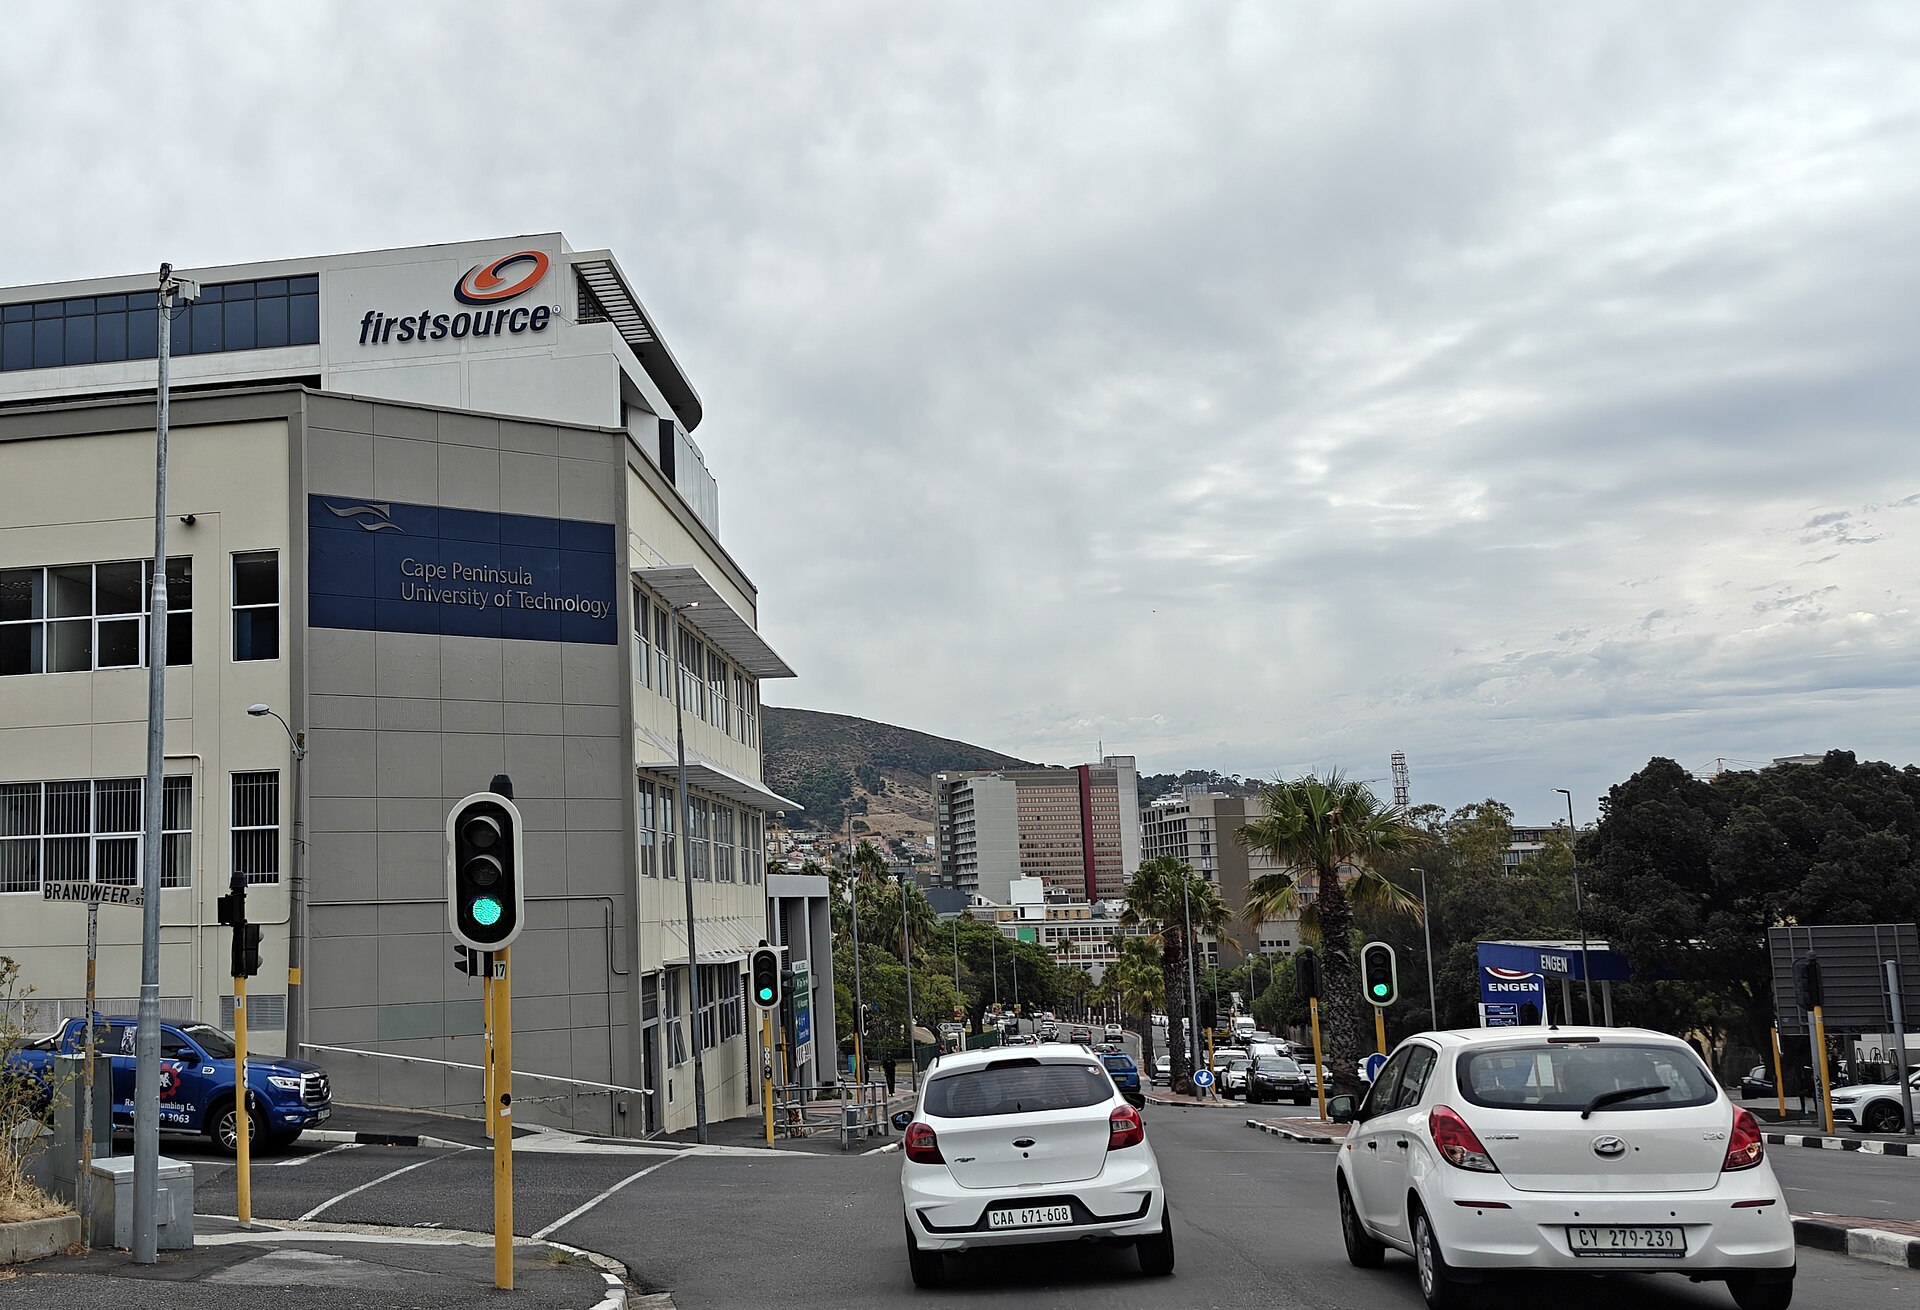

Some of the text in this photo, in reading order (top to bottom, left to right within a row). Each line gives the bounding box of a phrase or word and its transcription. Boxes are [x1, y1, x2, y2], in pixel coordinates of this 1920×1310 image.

[359, 305, 551, 345] firstsource
[400, 557, 533, 586] Cape Peninsula
[400, 582, 611, 618] University of Technology
[44, 882, 130, 904] BRANDWEER
[494, 963, 506, 977] 17
[1540, 954, 1568, 973] ENGEN
[1488, 982, 1540, 992] ENGEN
[168, 1113, 190, 1123] 3063
[992, 1207, 1069, 1226] CAA 671-608
[1579, 1229, 1674, 1248] CY 279-239
